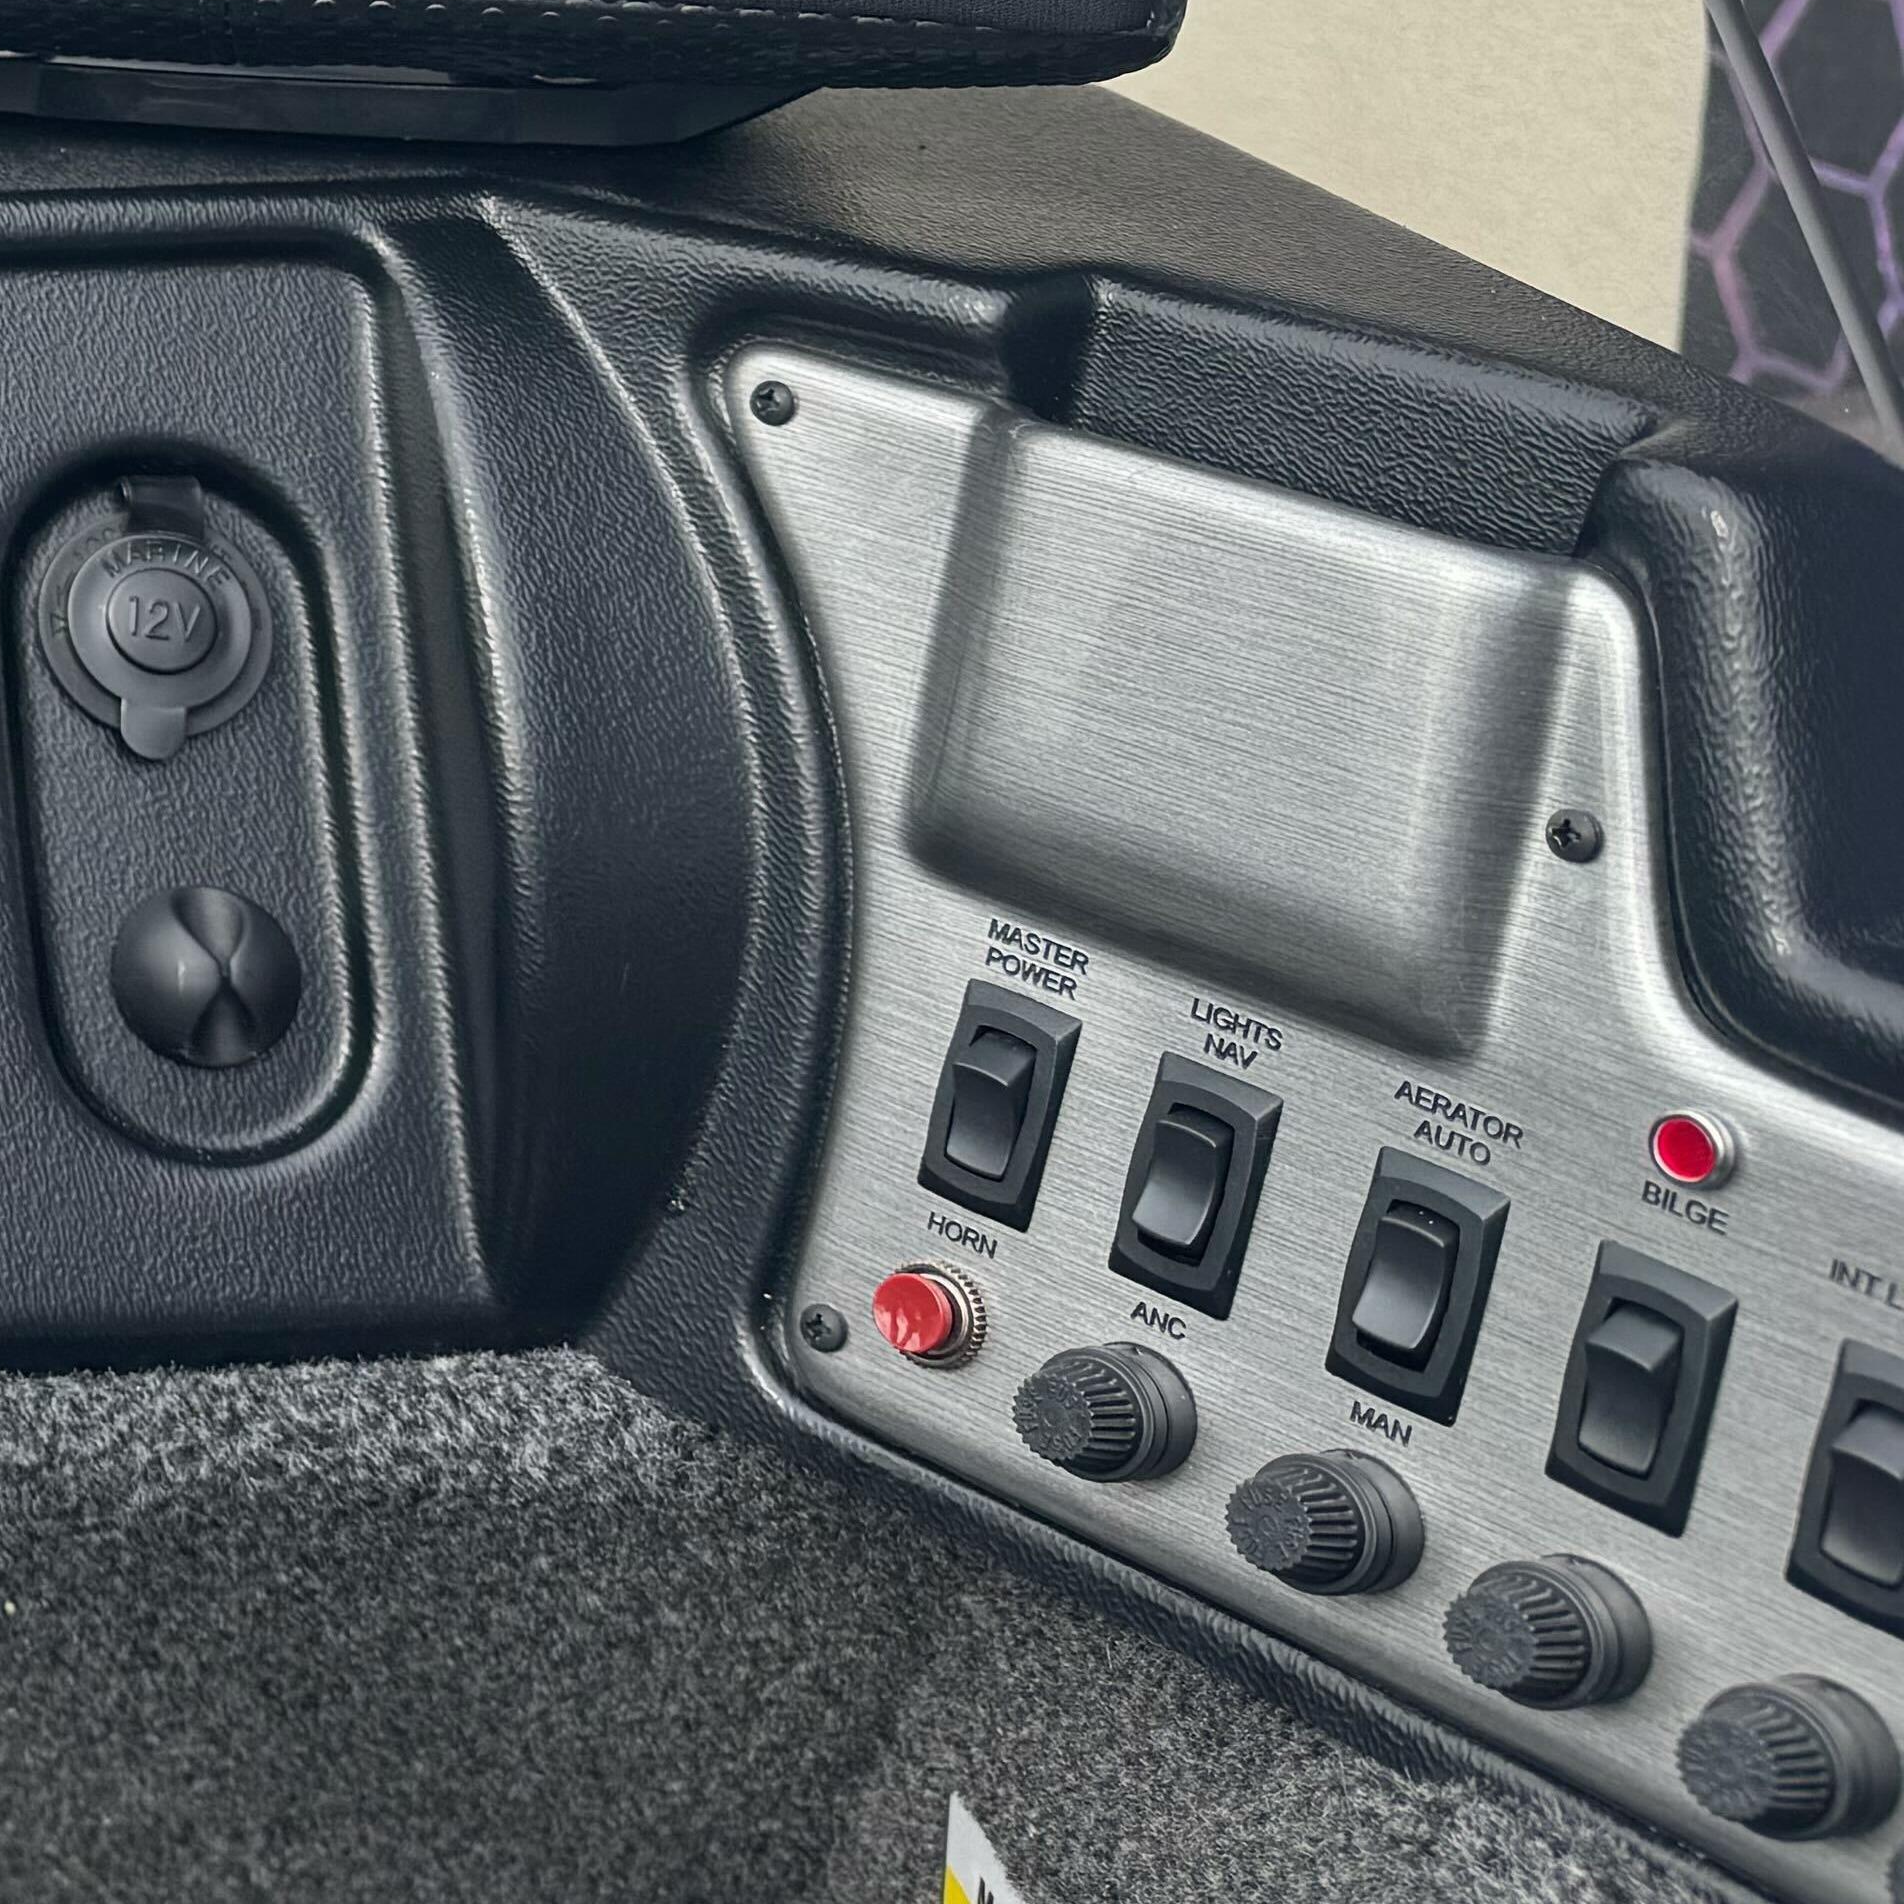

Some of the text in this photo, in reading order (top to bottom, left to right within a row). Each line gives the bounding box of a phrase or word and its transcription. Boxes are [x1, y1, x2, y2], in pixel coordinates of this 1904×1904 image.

[128, 596, 202, 643] 12V
[988, 918, 1089, 975] MASTER
[985, 947, 1078, 1001] POWER
[1191, 997, 1283, 1051] LIGHTS
[1203, 1033, 1258, 1070] NAV
[1394, 1080, 1524, 1149] AERATOR
[1413, 1120, 1491, 1166] AUTO
[1642, 1180, 1729, 1236] BILGE
[927, 1211, 998, 1259] HORN
[1829, 1258, 1882, 1296] INT
[1130, 1301, 1187, 1341] ANC
[1349, 1400, 1413, 1447] MAN
